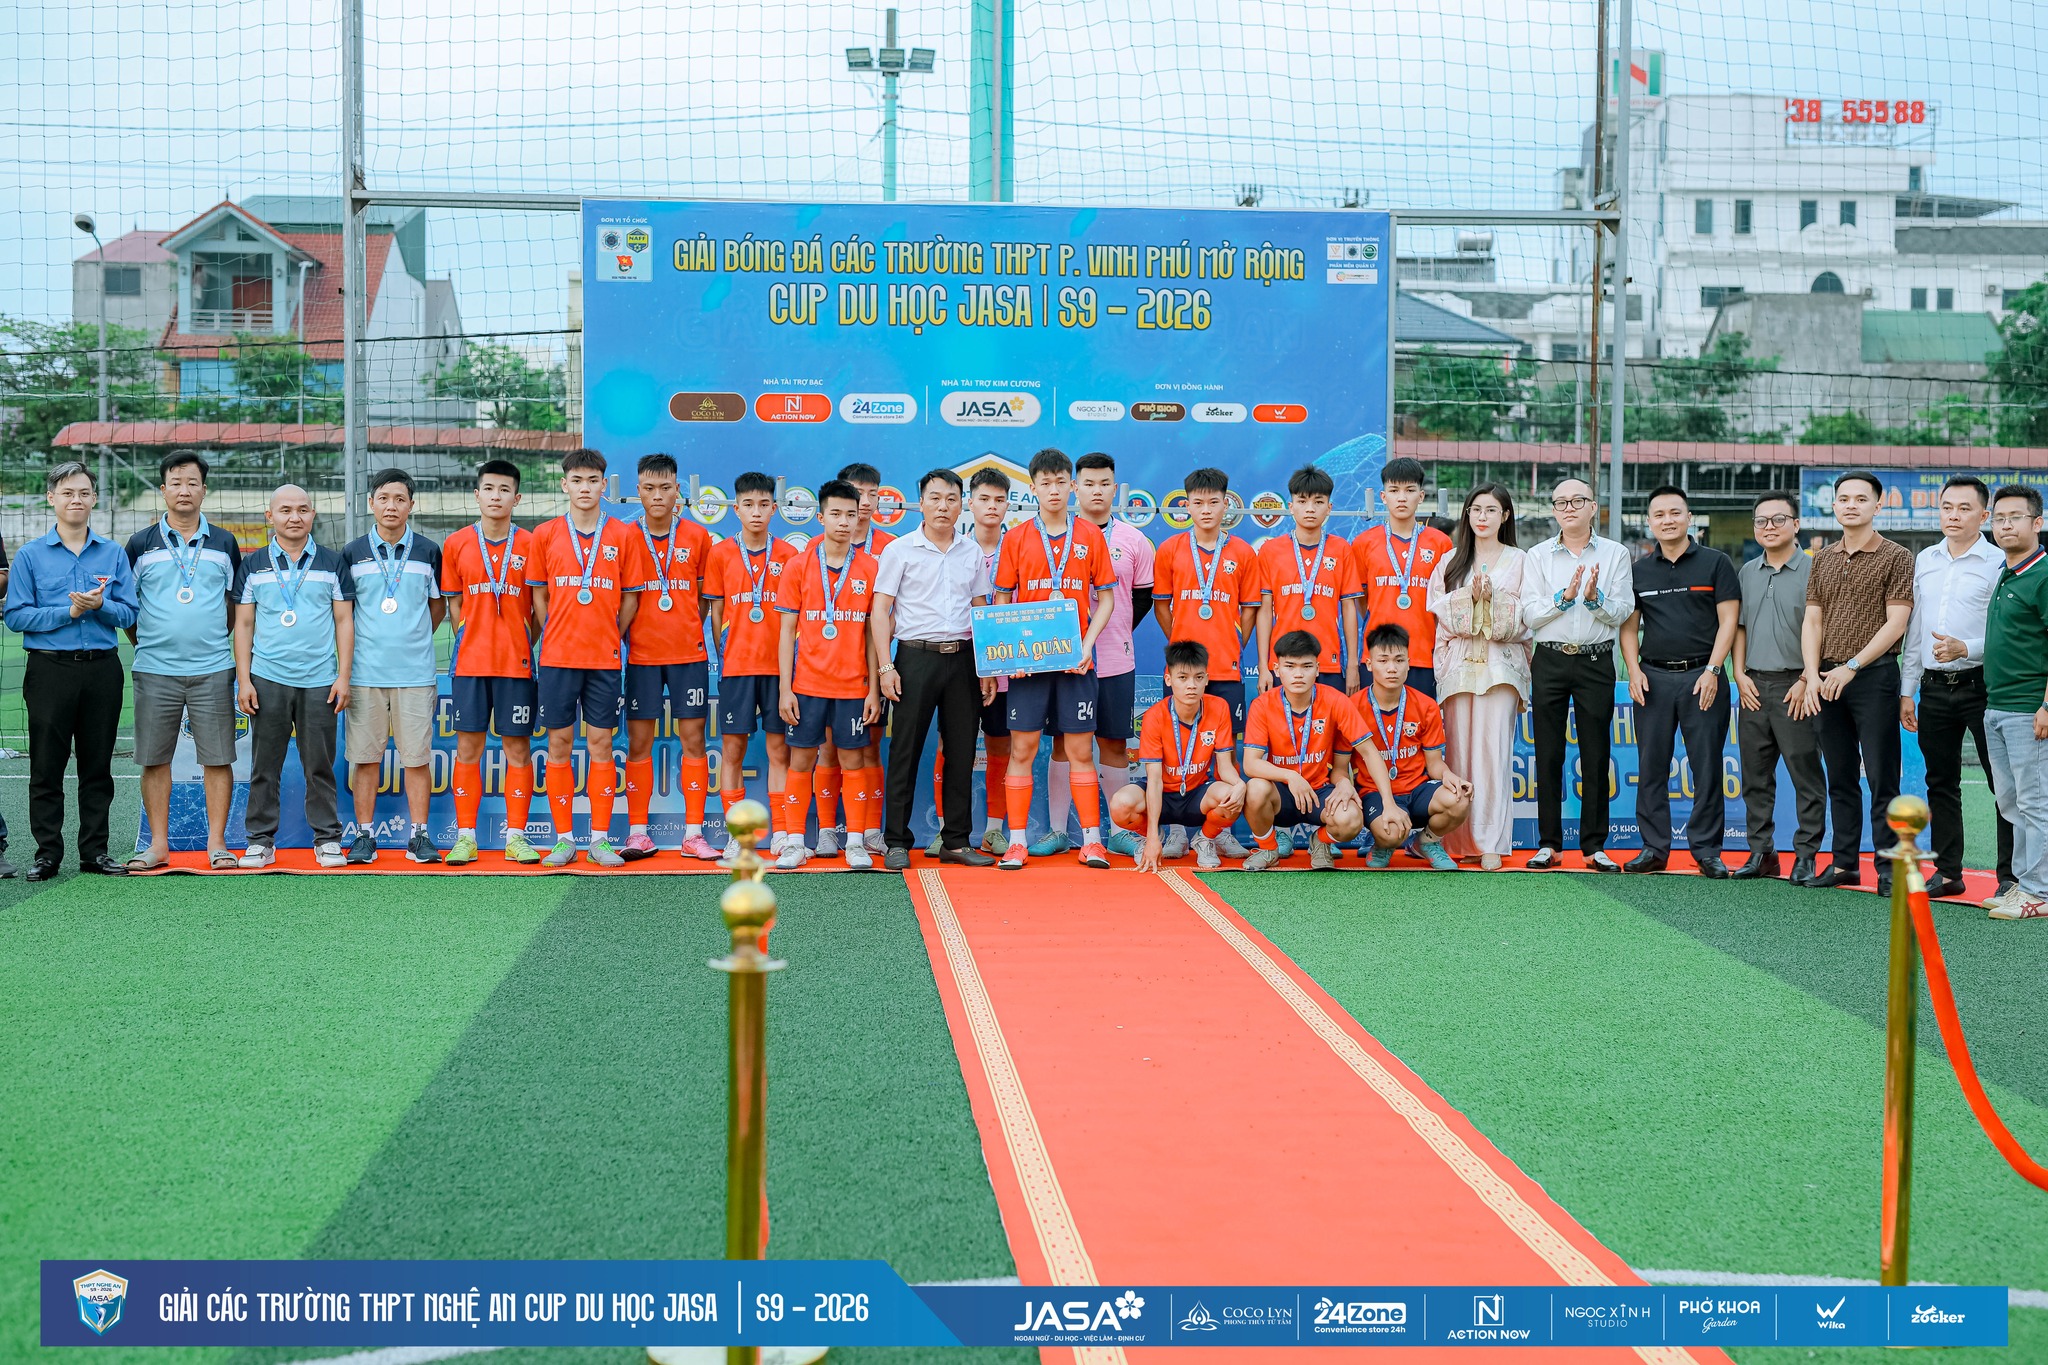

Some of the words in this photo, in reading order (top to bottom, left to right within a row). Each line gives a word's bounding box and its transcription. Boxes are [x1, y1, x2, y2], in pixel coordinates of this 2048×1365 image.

[673, 232, 716, 272] GIẢI
[723, 232, 786, 273] BÓNG
[791, 234, 824, 273] ĐÁ
[830, 234, 876, 273] CÁC
[883, 234, 984, 275] TRƯỜNG
[991, 242, 1051, 275] THPT
[1058, 243, 1081, 277] P.
[1087, 244, 1138, 278] VINH
[1144, 239, 1192, 278] PHÚ
[1198, 240, 1237, 280] MỞ
[1243, 241, 1305, 287] RỘNG
[769, 282, 828, 325] CUP
[837, 282, 879, 326] DU
[888, 283, 947, 335] HỌC
[958, 283, 1033, 327] JASA
[1058, 285, 1098, 328] S9
[1136, 287, 1212, 330] 2026
[942, 379, 959, 387] NHÀ
[961, 379, 973, 387] TÀI
[975, 380, 992, 388] TRỢ
[1010, 380, 1041, 388] CƯƠNG
[1204, 383, 1224, 391] HÀNH
[873, 402, 903, 413] Zone
[957, 402, 1013, 417] JASA
[986, 641, 1014, 662] ĐỘI
[1017, 640, 1029, 658] Á
[1032, 636, 1073, 661] QUÂN
[686, 687, 704, 706] 30
[512, 705, 530, 724] 28
[1077, 701, 1094, 721] 24
[851, 717, 864, 735] 14
[702, 818, 721, 828] PHỞ
